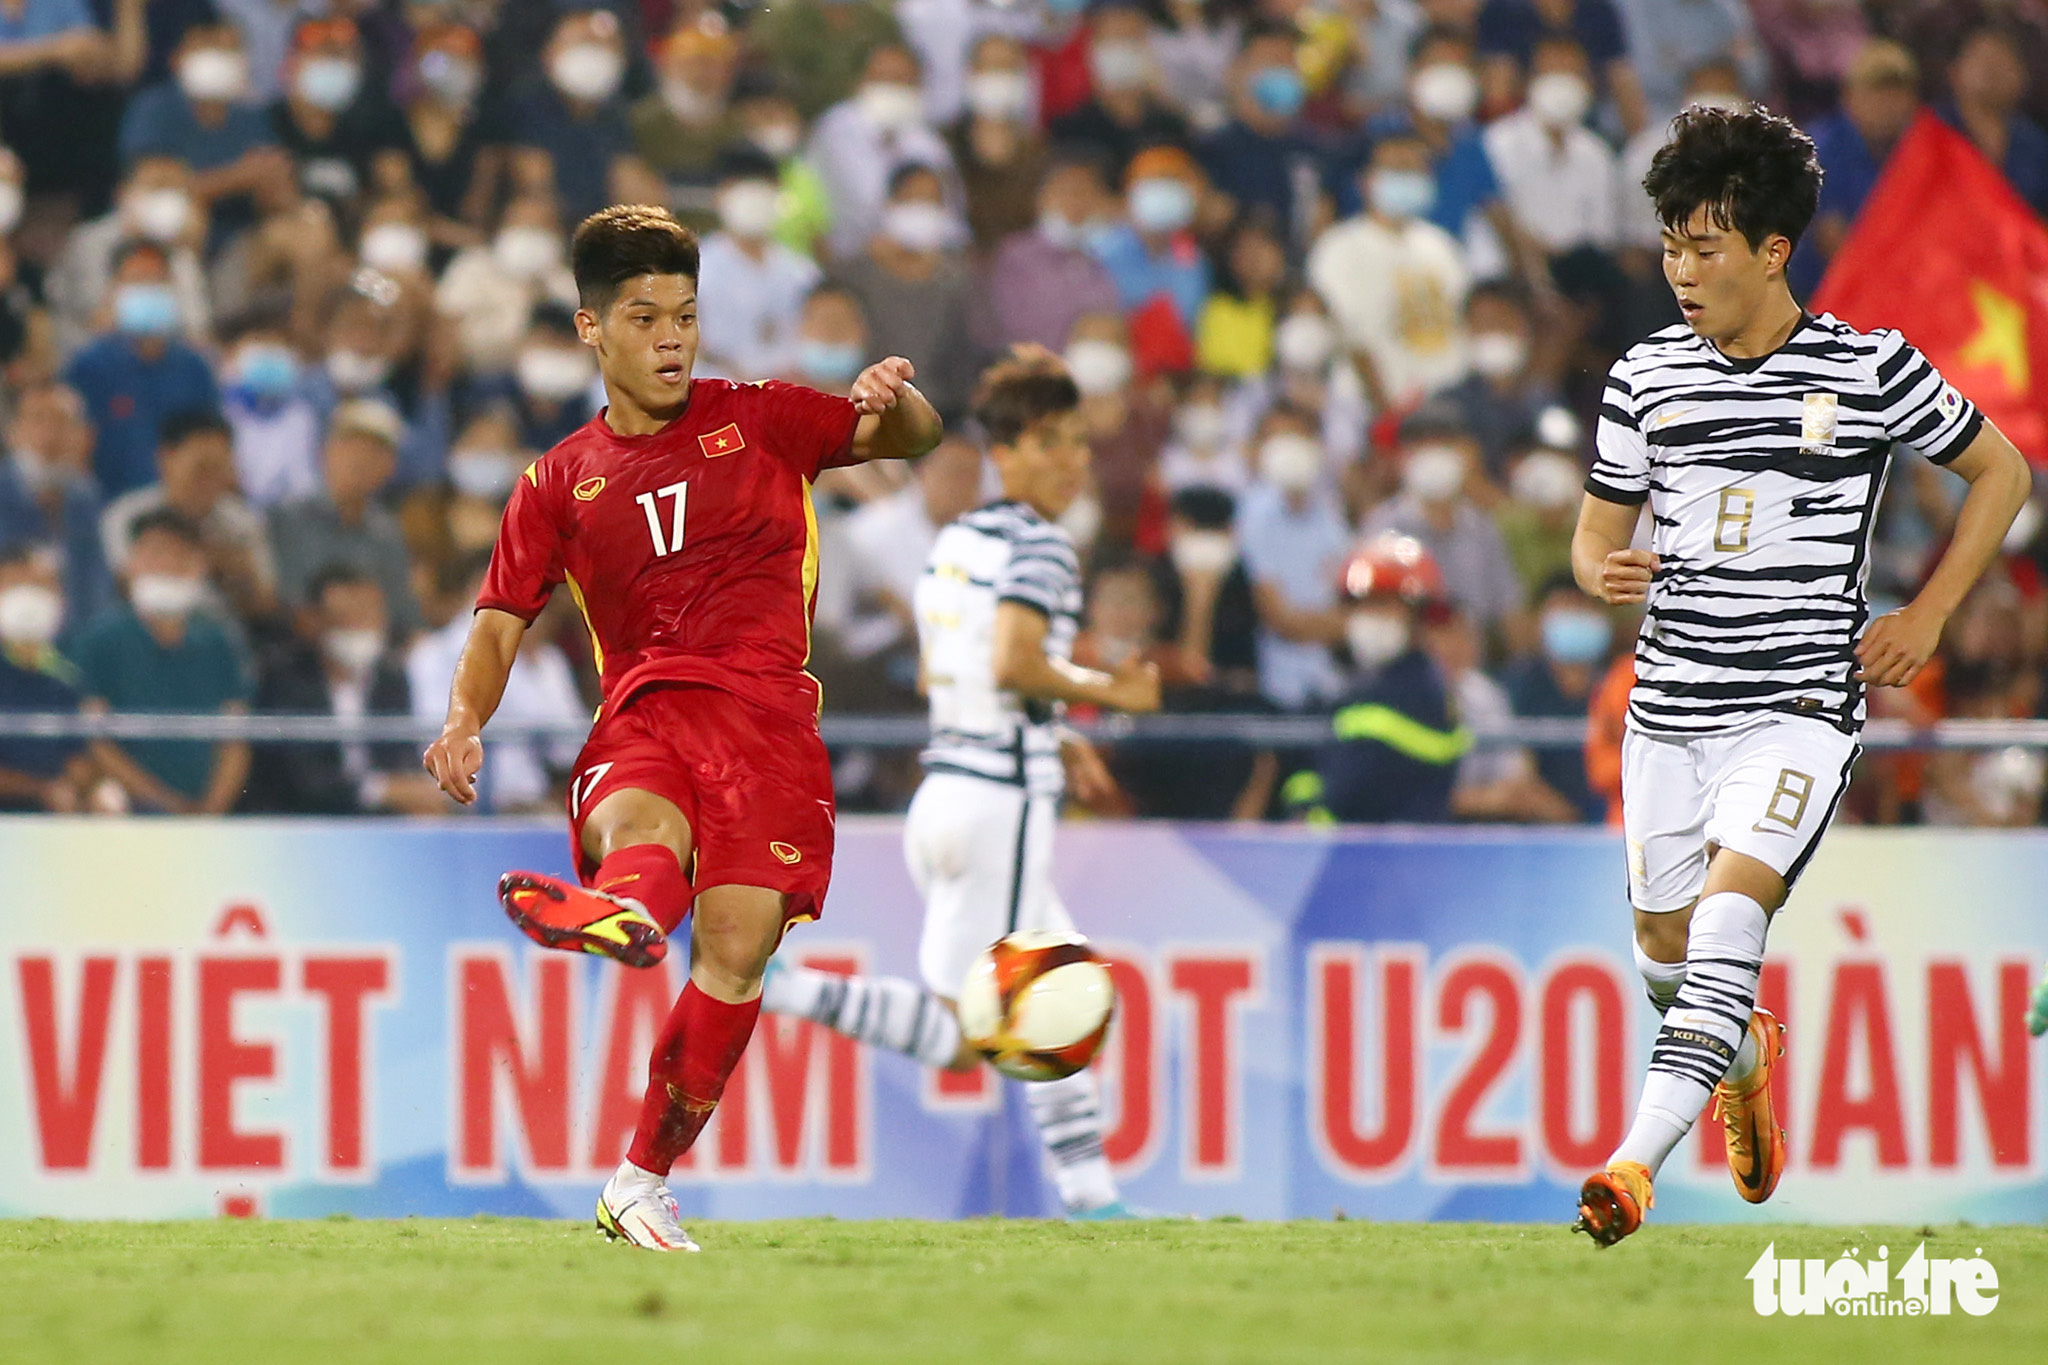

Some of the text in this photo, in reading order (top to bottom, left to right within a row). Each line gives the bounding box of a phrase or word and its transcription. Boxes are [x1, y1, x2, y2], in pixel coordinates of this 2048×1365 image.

[636, 481, 688, 557] 17
[1714, 488, 1755, 553] 8
[571, 761, 615, 820] 17
[1765, 767, 1815, 832] 8
[17, 905, 390, 1218] VIỆT
[1319, 958, 1626, 1172] U20
[1672, 1029, 1729, 1058] KOREA
